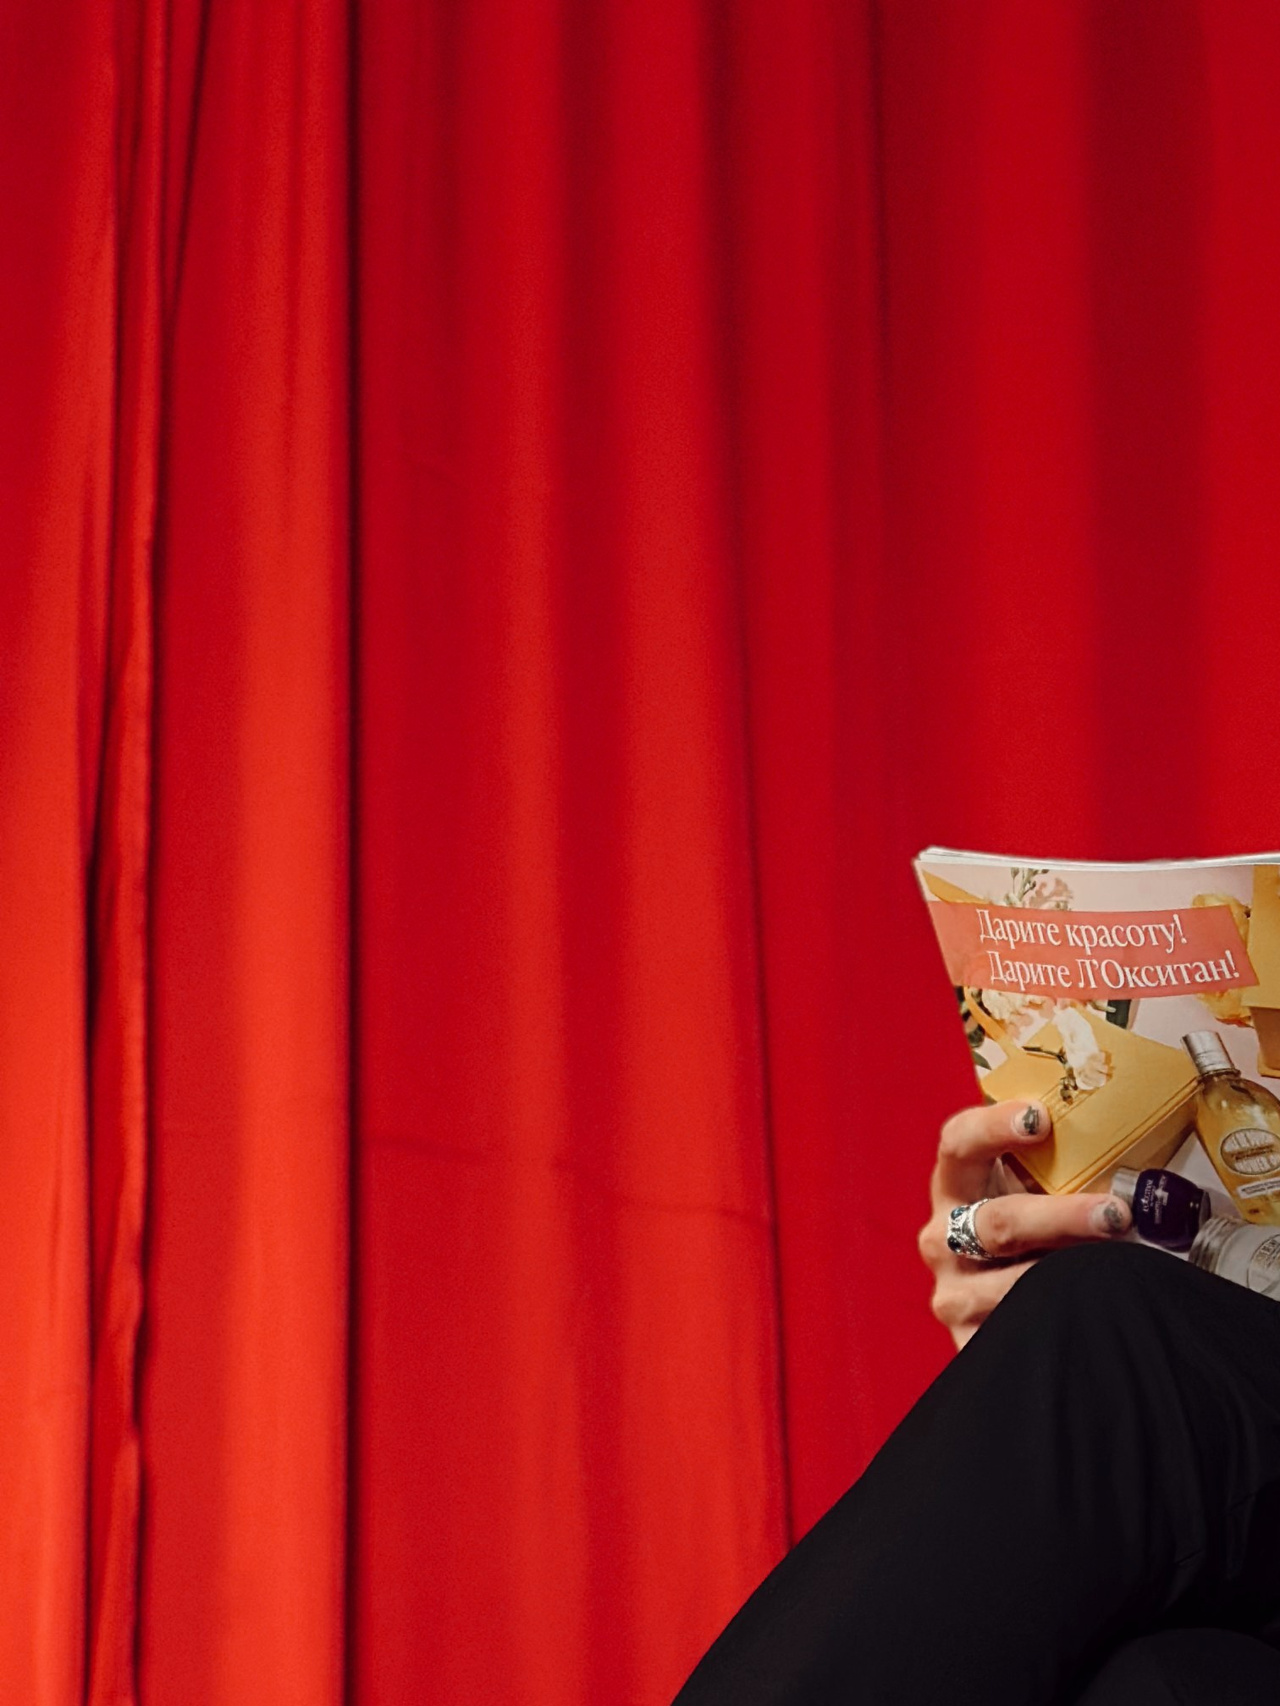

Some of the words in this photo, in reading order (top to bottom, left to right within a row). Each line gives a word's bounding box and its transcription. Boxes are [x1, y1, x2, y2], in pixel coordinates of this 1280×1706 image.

[976, 909, 1062, 949] Дарите
[1066, 914, 1188, 955] красоту!
[987, 951, 1073, 991] Дарите
[1075, 950, 1241, 990] Л'Окситан!
